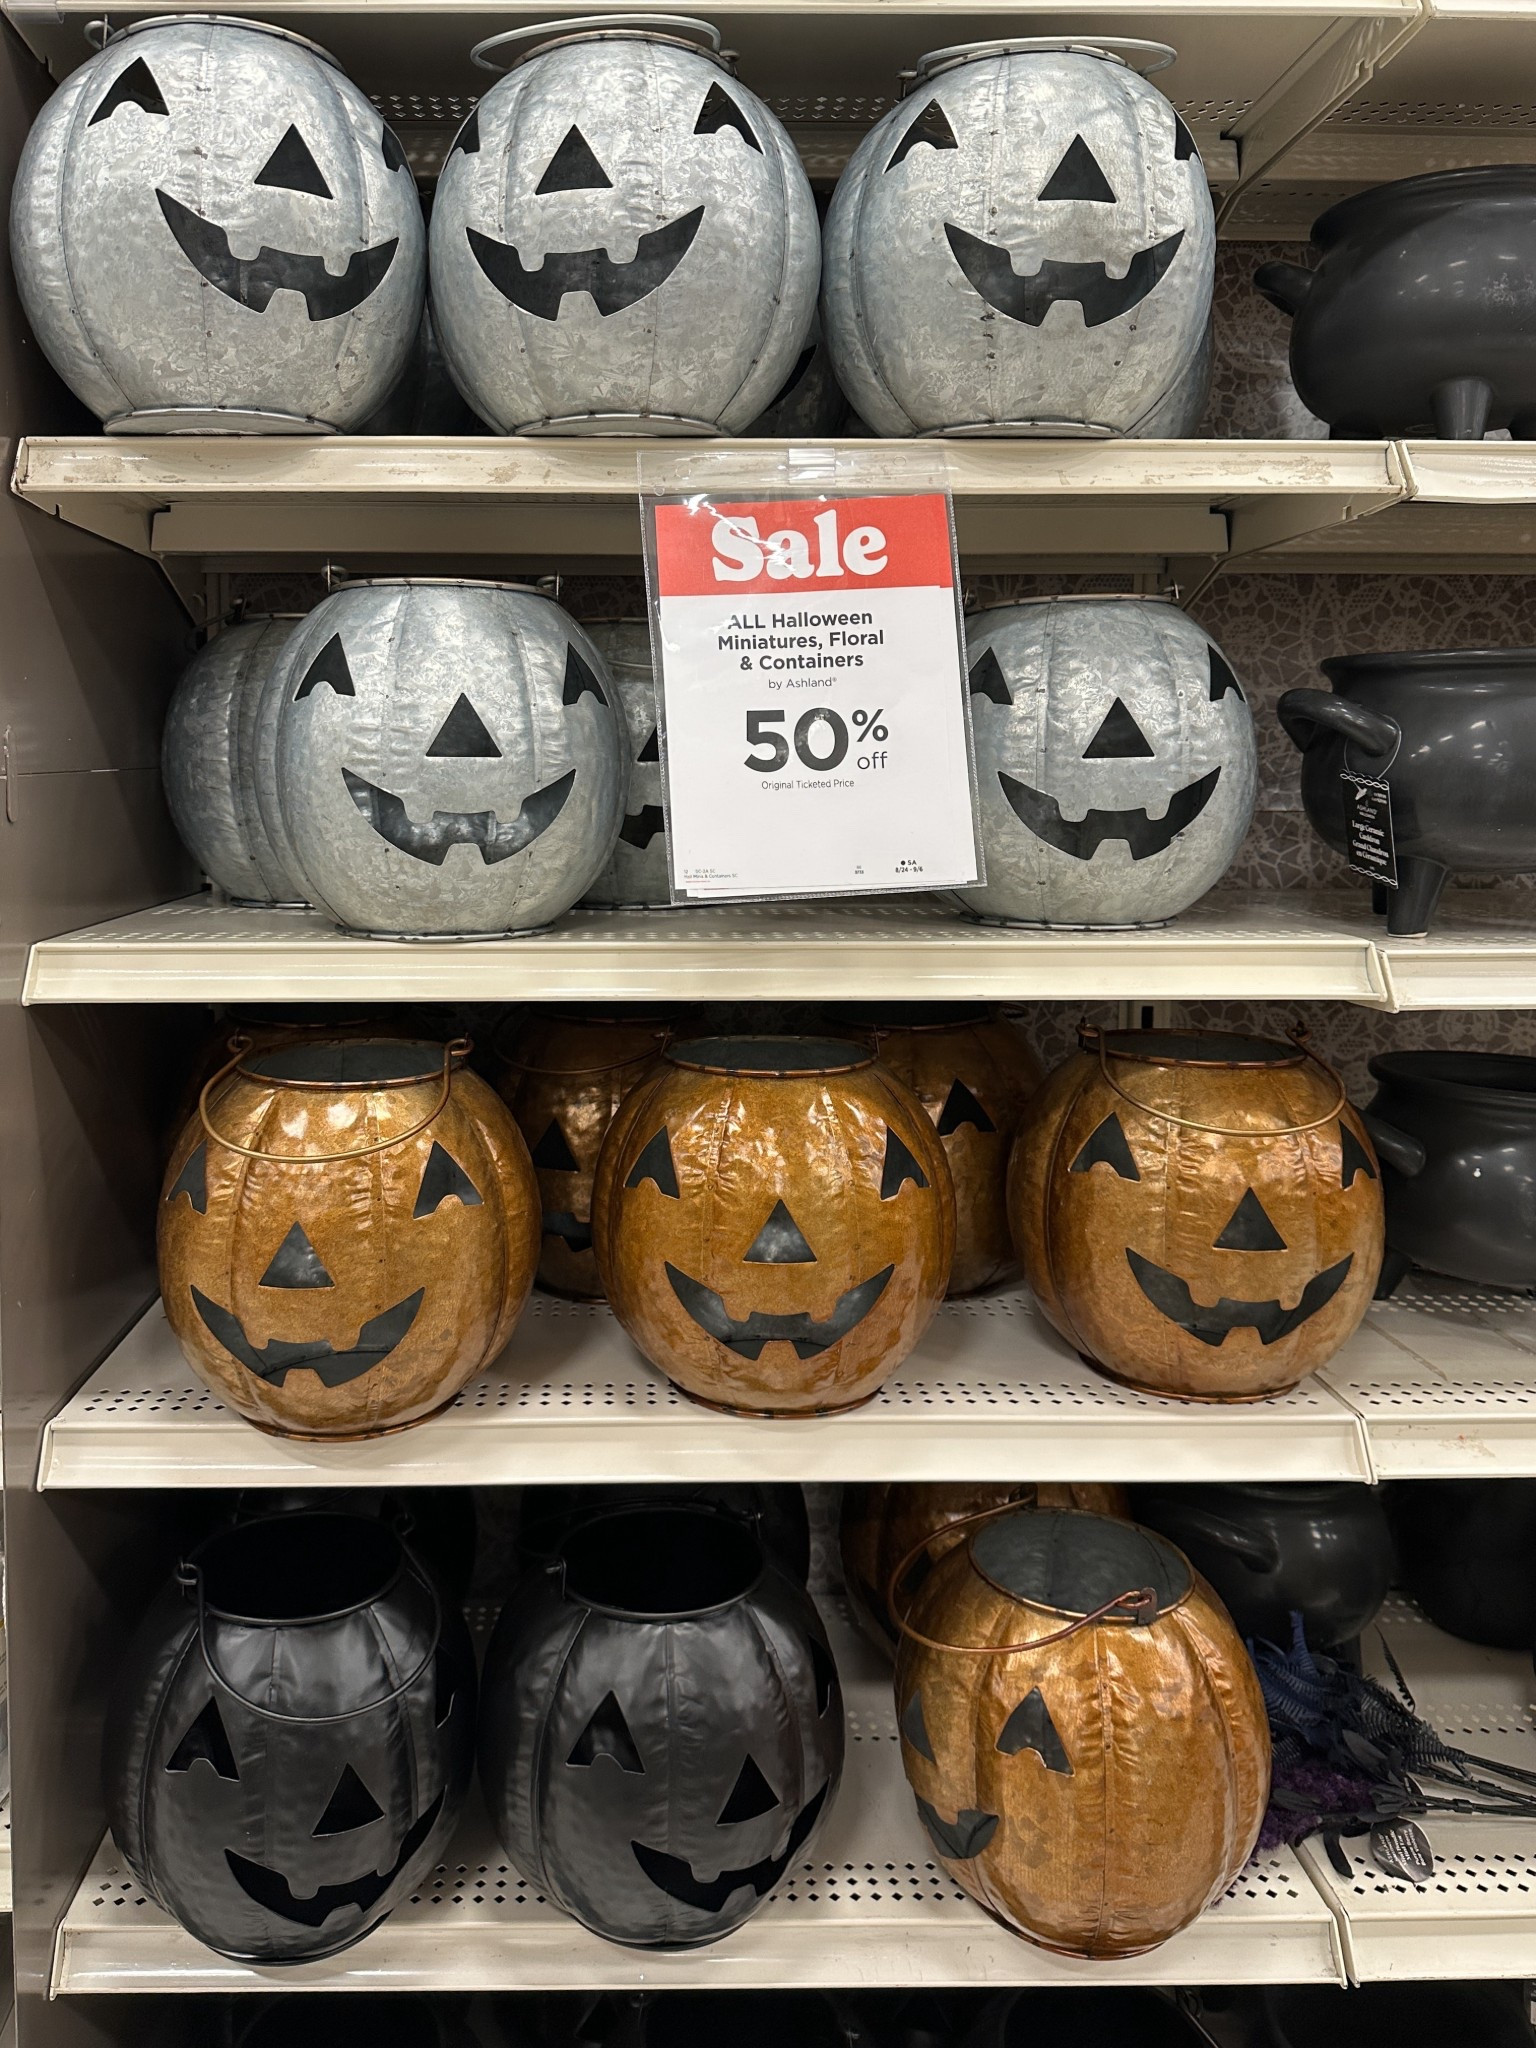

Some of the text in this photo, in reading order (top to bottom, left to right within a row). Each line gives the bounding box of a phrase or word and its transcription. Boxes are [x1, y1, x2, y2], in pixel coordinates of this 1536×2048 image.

[711, 508, 888, 582] Sale
[727, 611, 873, 630] ALL Halloween
[718, 630, 884, 650] Miniatures, Floral
[740, 653, 864, 670] & Containers
[768, 679, 783, 690] by
[857, 751, 888, 770] off
[761, 779, 855, 791] Original Ticketed Price
